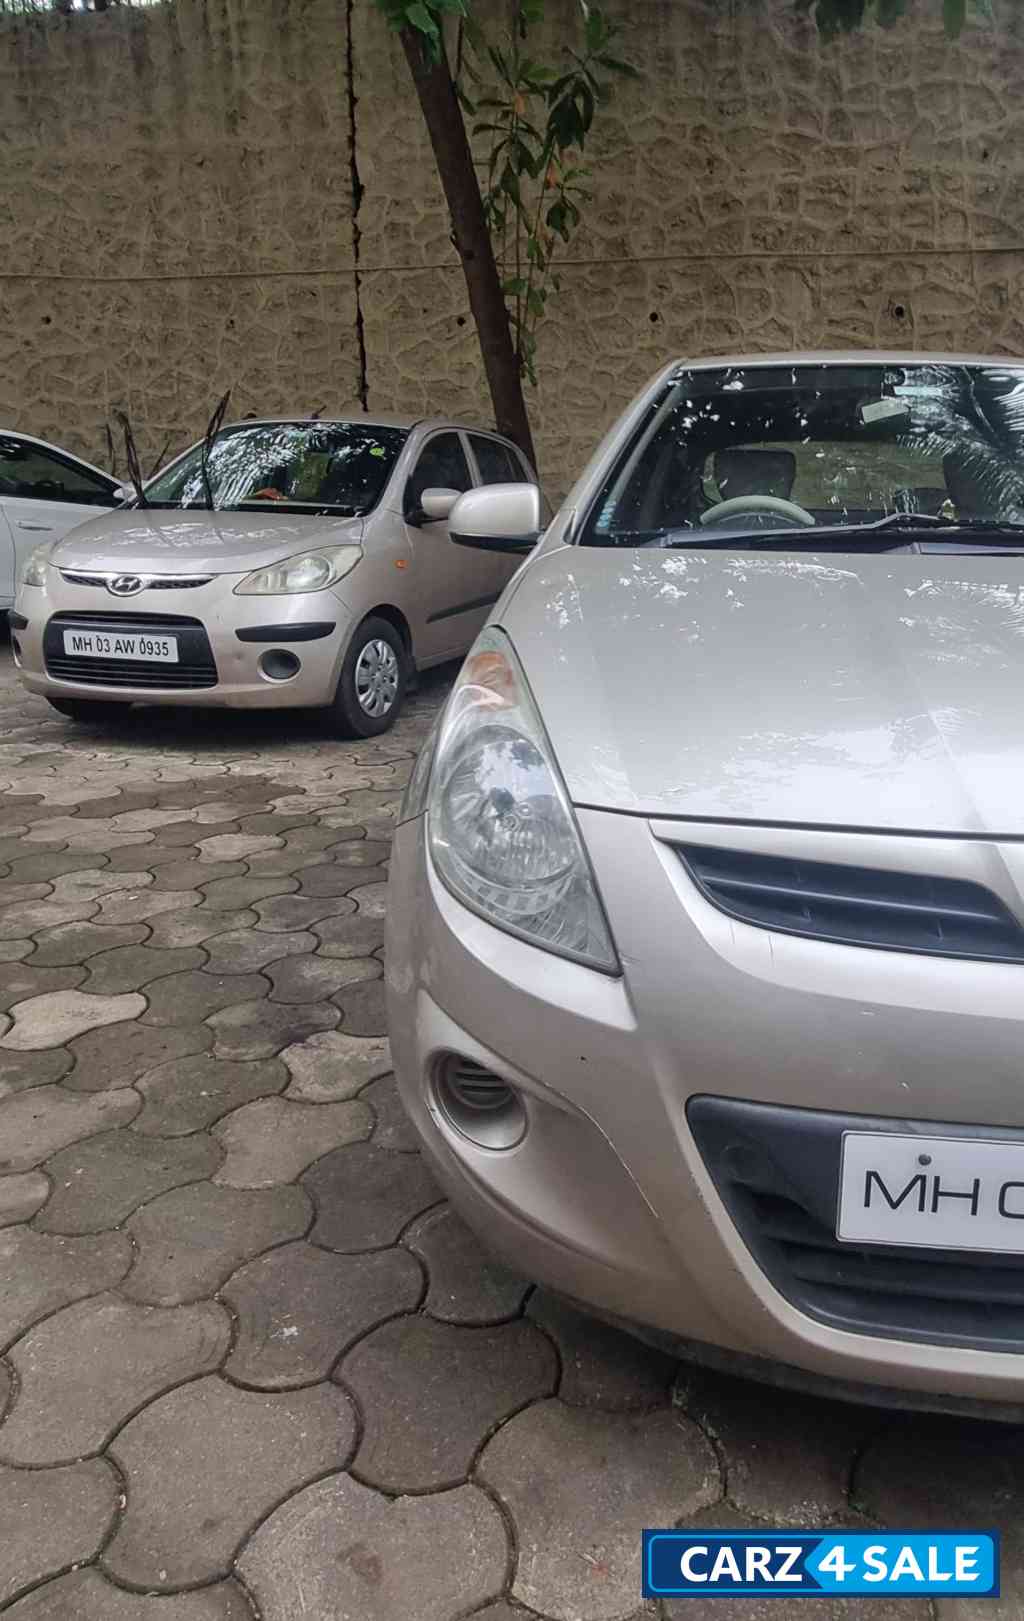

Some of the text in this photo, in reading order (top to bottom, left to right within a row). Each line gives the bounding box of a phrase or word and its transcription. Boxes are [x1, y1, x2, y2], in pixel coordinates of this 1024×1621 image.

[72, 636, 169, 657] MH 03 AW 0935
[863, 1170, 981, 1217] MH
